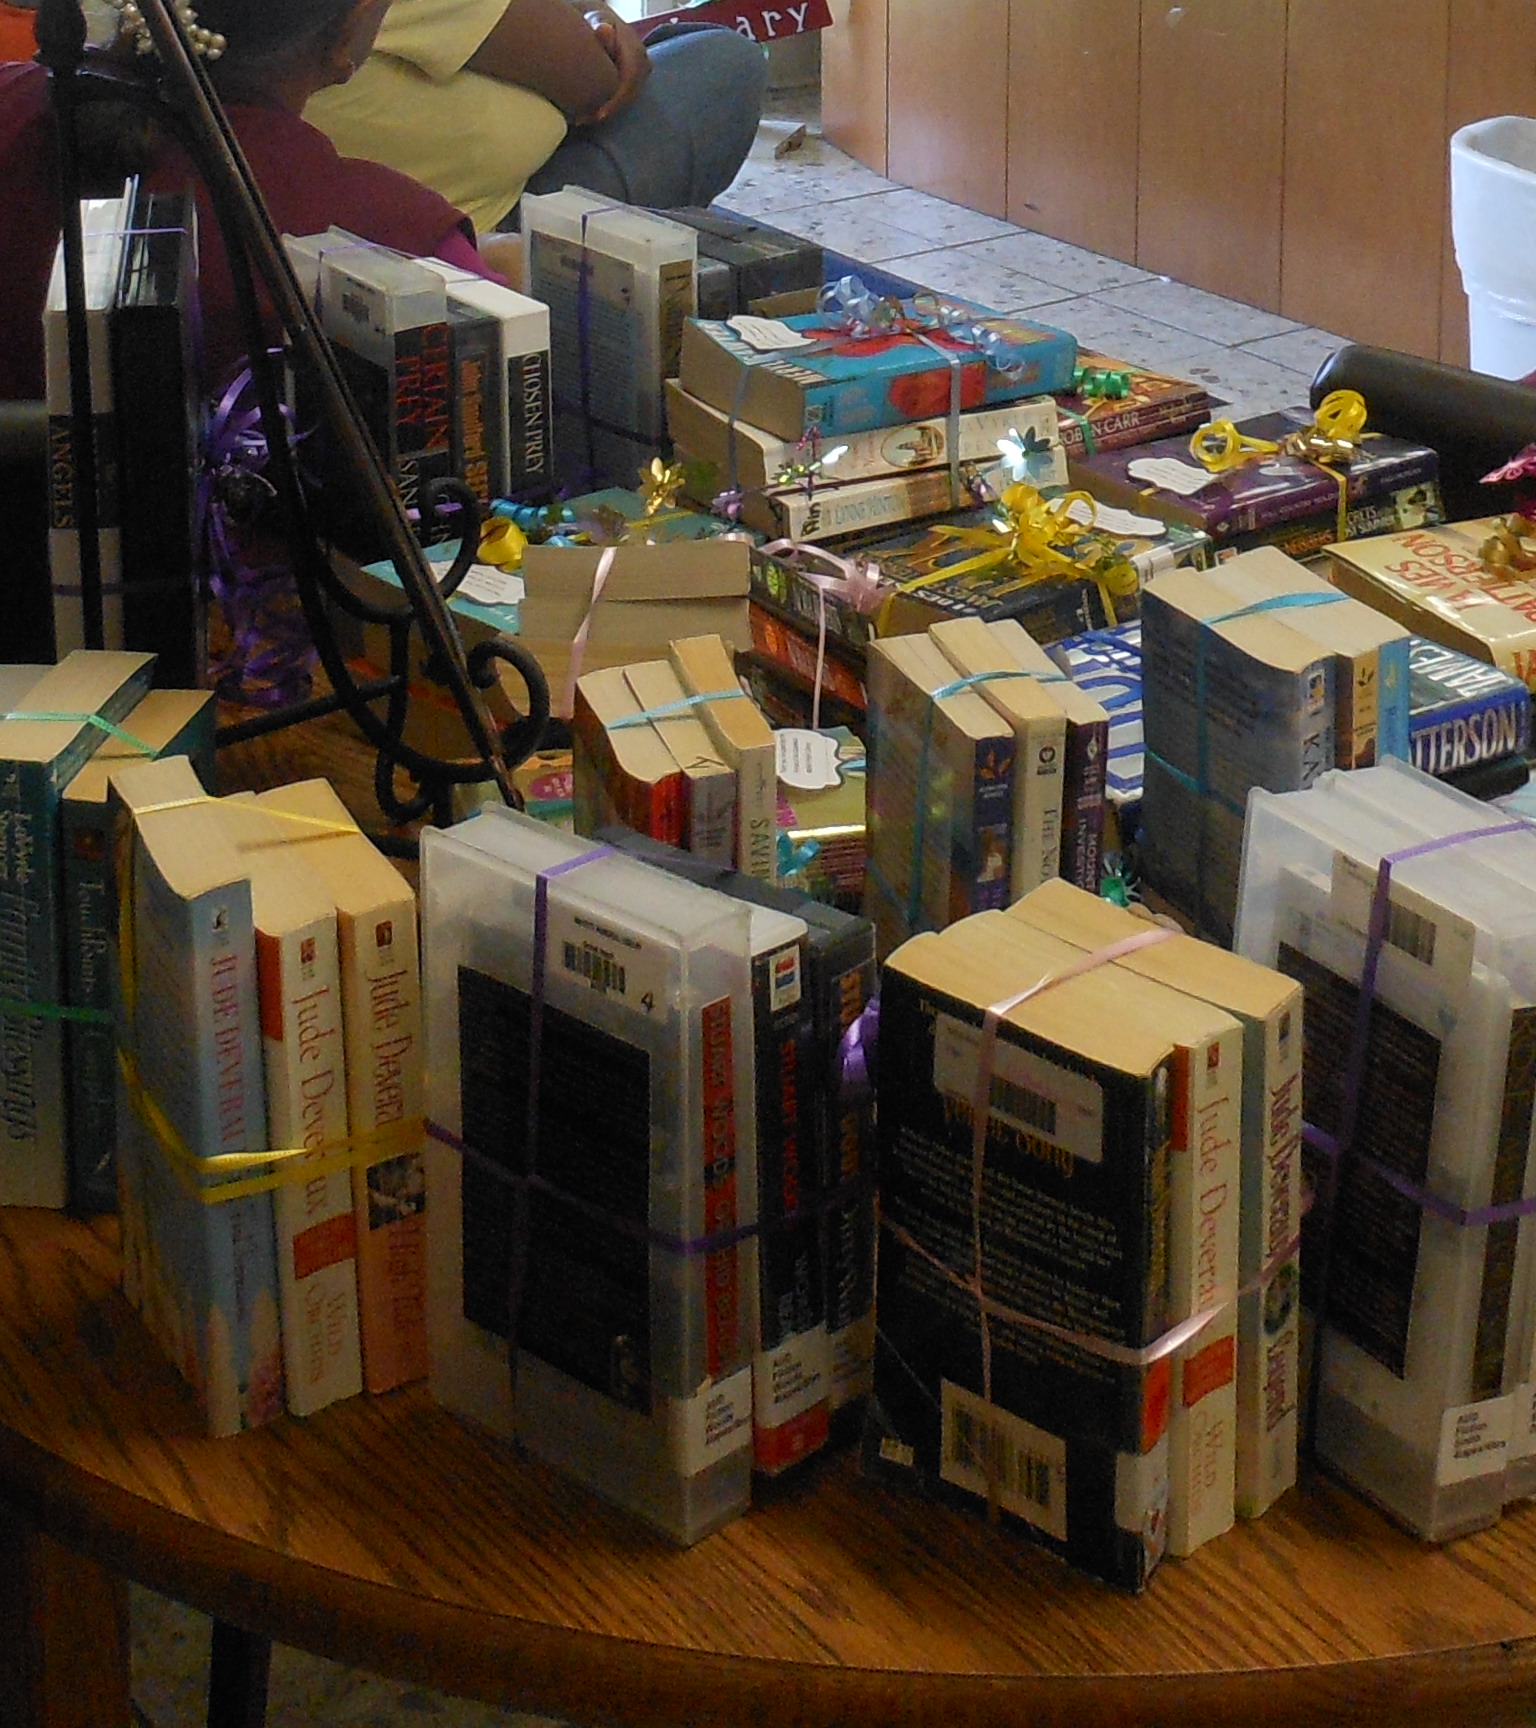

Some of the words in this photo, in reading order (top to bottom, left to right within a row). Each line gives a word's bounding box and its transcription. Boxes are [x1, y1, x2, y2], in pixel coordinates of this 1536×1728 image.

[396, 354, 422, 425] PREY
[422, 322, 451, 449] CERTAIN
[522, 352, 544, 427] CHOSEN
[524, 429, 546, 474] PREY
[1105, 410, 1140, 434] CARR
[292, 985, 336, 1064] Jude
[367, 968, 410, 1030] Jude
[640, 989, 655, 1013] 4
[1196, 1096, 1232, 1173] Jude
